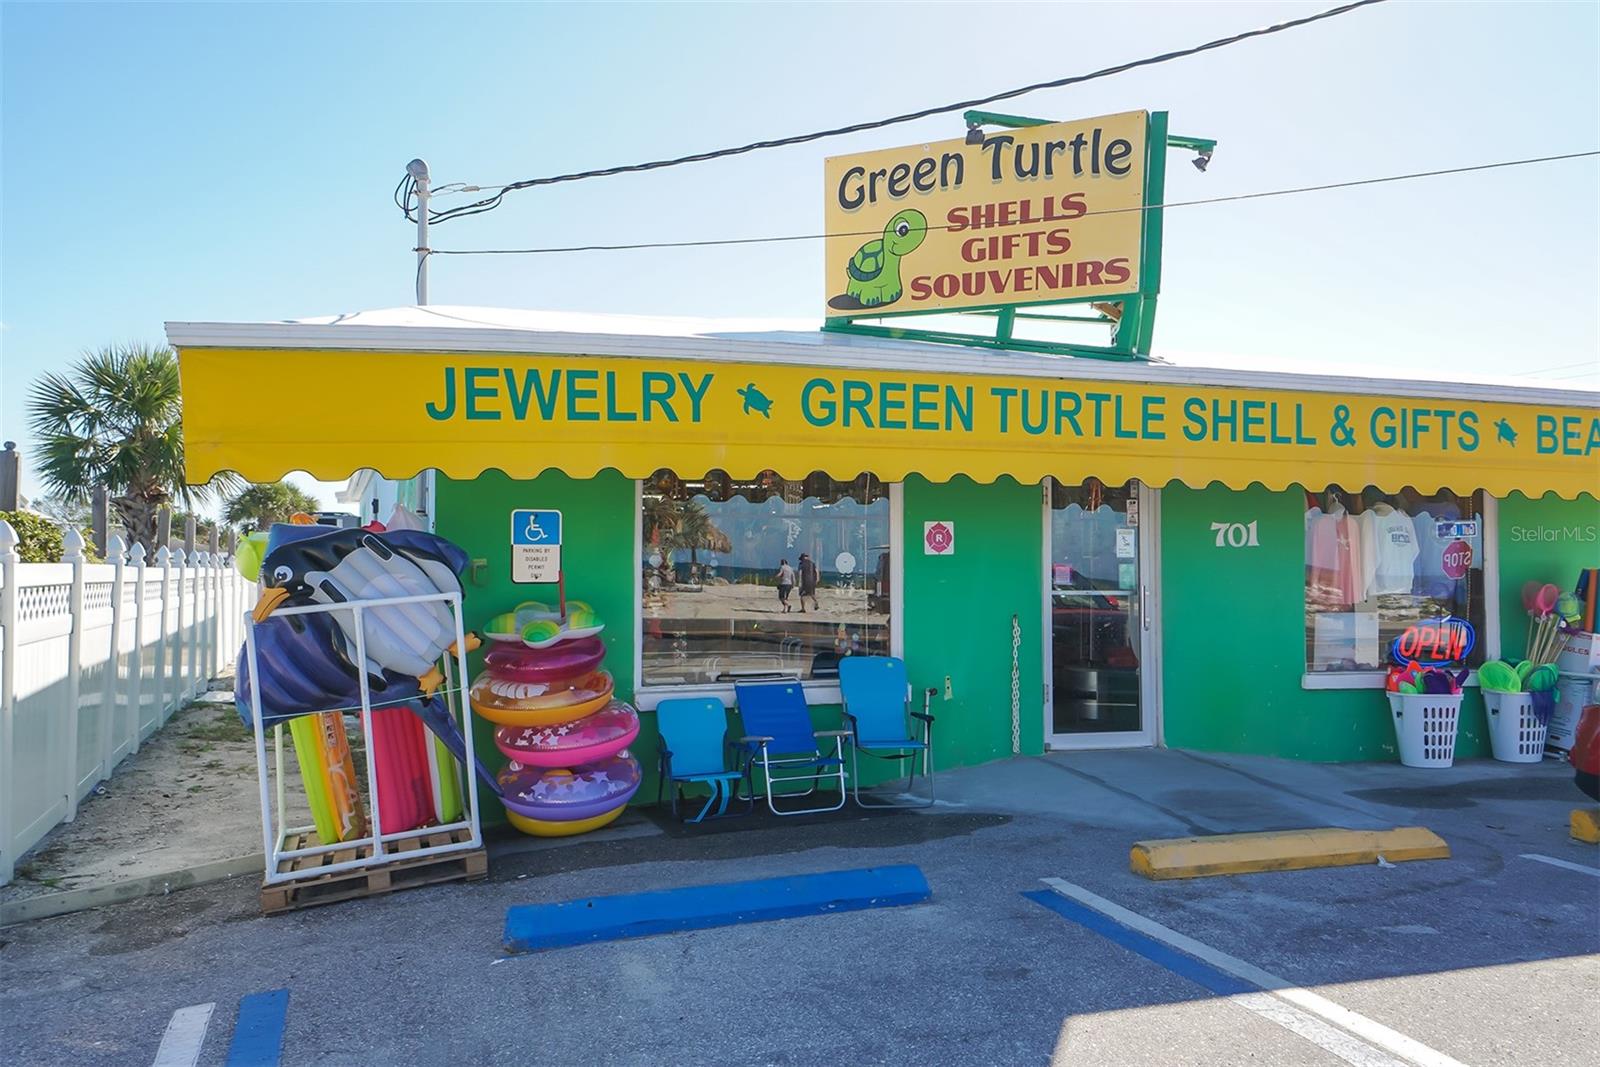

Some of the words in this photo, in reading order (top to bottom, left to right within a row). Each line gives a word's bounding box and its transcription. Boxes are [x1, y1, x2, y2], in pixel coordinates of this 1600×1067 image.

[838, 152, 964, 211] Green
[982, 128, 1133, 180] Turtle
[946, 192, 1088, 233] SHELLS
[961, 229, 1072, 263] GIFTS
[910, 257, 1131, 301] SOUVENIRS
[426, 367, 714, 423] JEWELRY
[802, 378, 974, 432] GREEN
[991, 387, 1166, 440] TURTLE
[1183, 397, 1317, 446] SHELL
[1330, 404, 1357, 447] &
[1370, 406, 1481, 452] GIFTS
[936, 534, 943, 542] R
[1210, 520, 1260, 548] 701
[1400, 624, 1466, 661] OPEN
